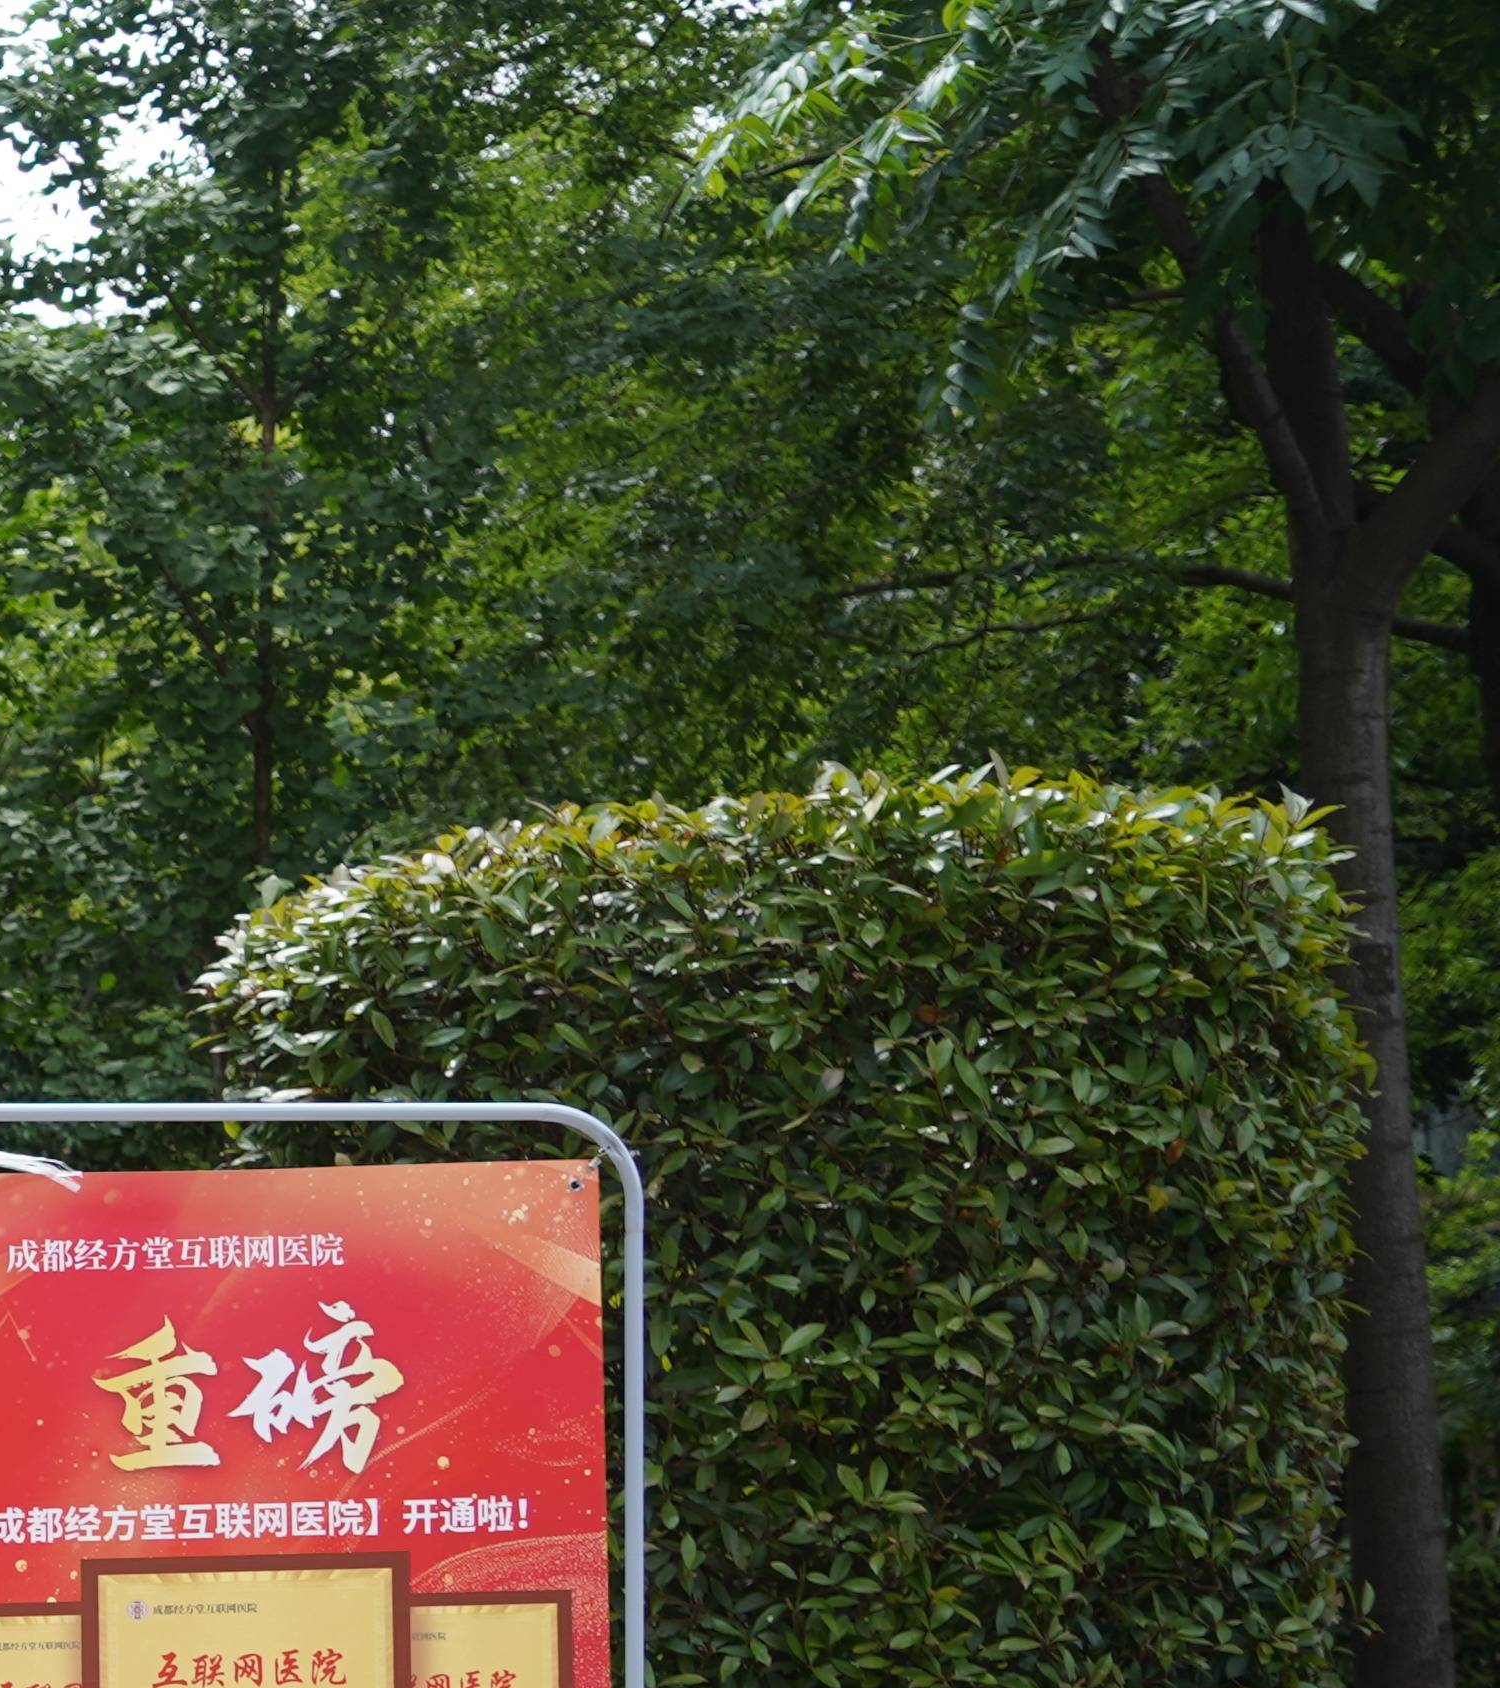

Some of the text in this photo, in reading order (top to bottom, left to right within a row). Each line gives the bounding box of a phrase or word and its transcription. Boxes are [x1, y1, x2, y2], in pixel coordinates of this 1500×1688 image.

[6, 1231, 345, 1274] 成都经方堂互联网医院
[92, 1300, 404, 1475] 重磅
[152, 1648, 347, 1688] 互联网医院
